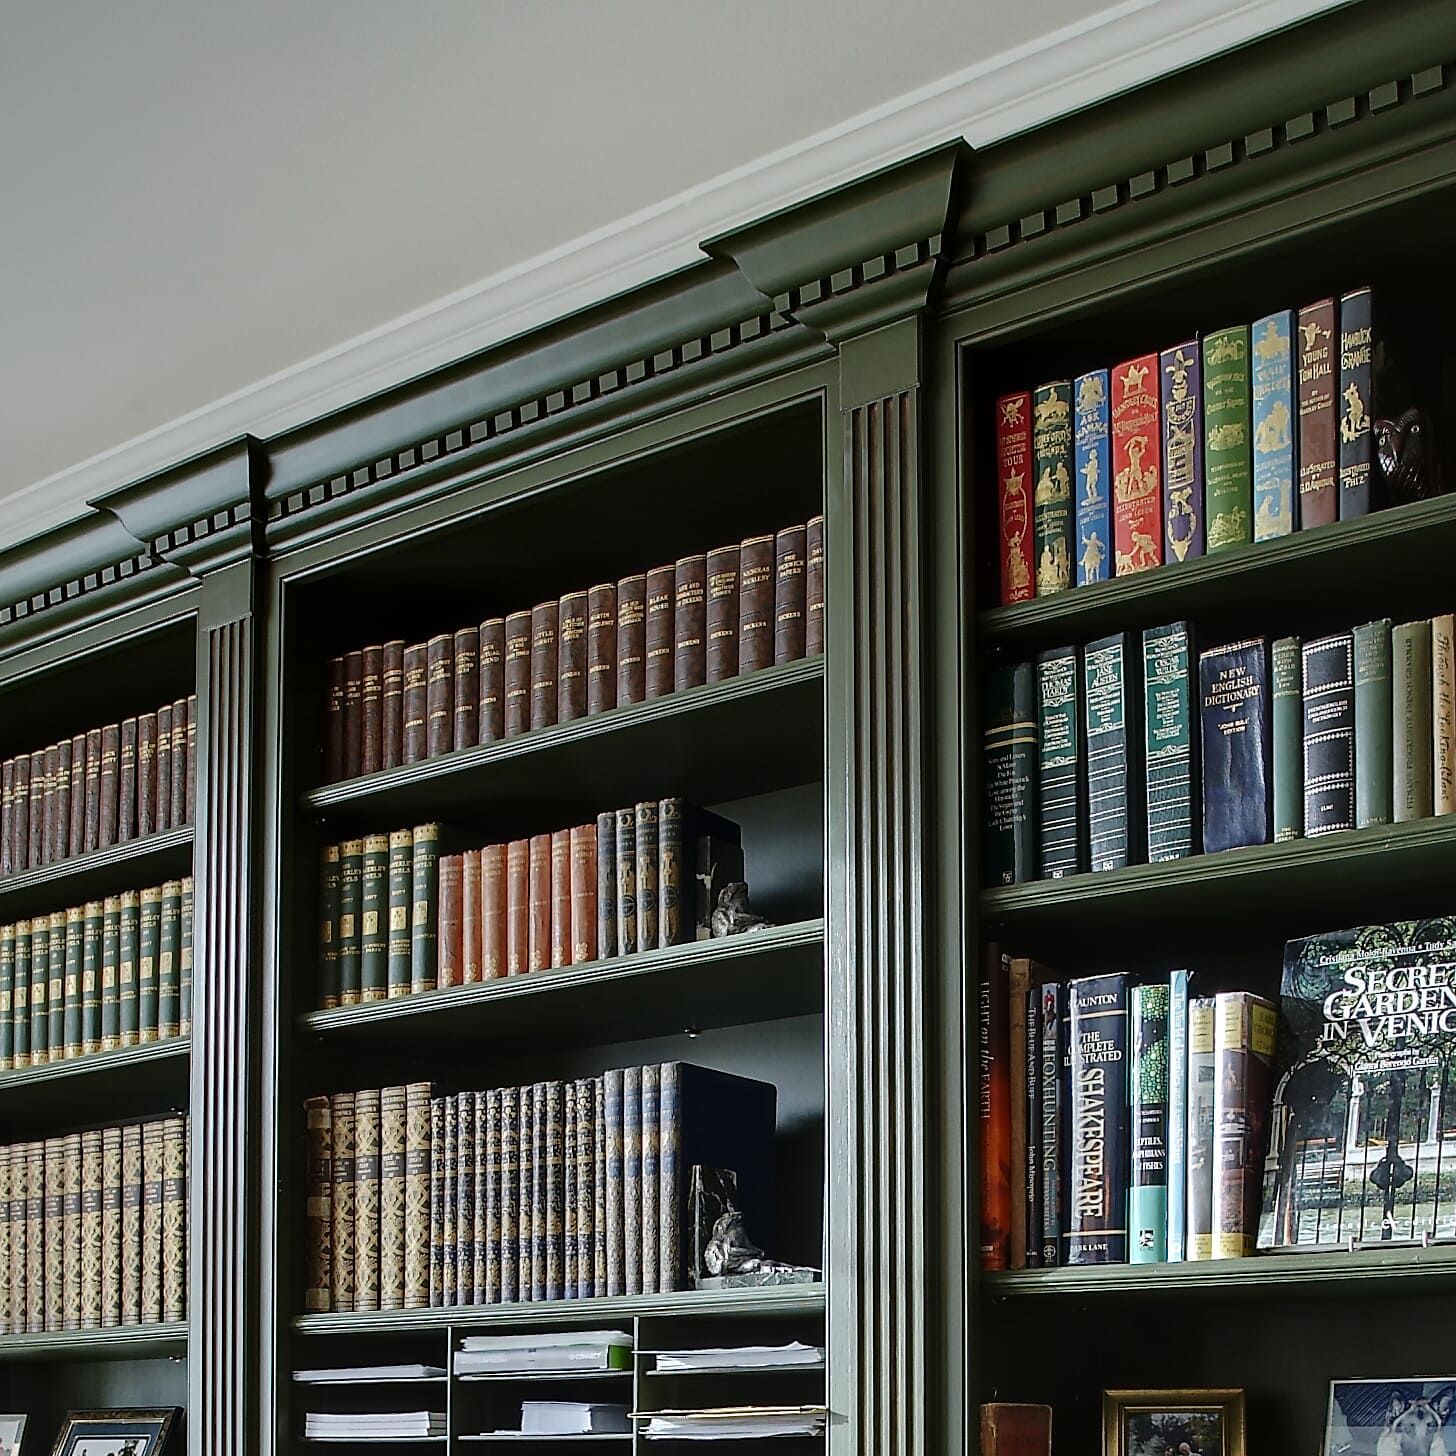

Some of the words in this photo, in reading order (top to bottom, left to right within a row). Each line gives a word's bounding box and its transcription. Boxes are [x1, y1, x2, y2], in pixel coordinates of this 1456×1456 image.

[1219, 666, 1247, 681] NEW
[1210, 676, 1255, 693] ENGLISH
[1204, 685, 1261, 707] DICTIONARY
[1323, 1022, 1348, 1042] IN
[1078, 1068, 1105, 1218] SHAKESPEARE
